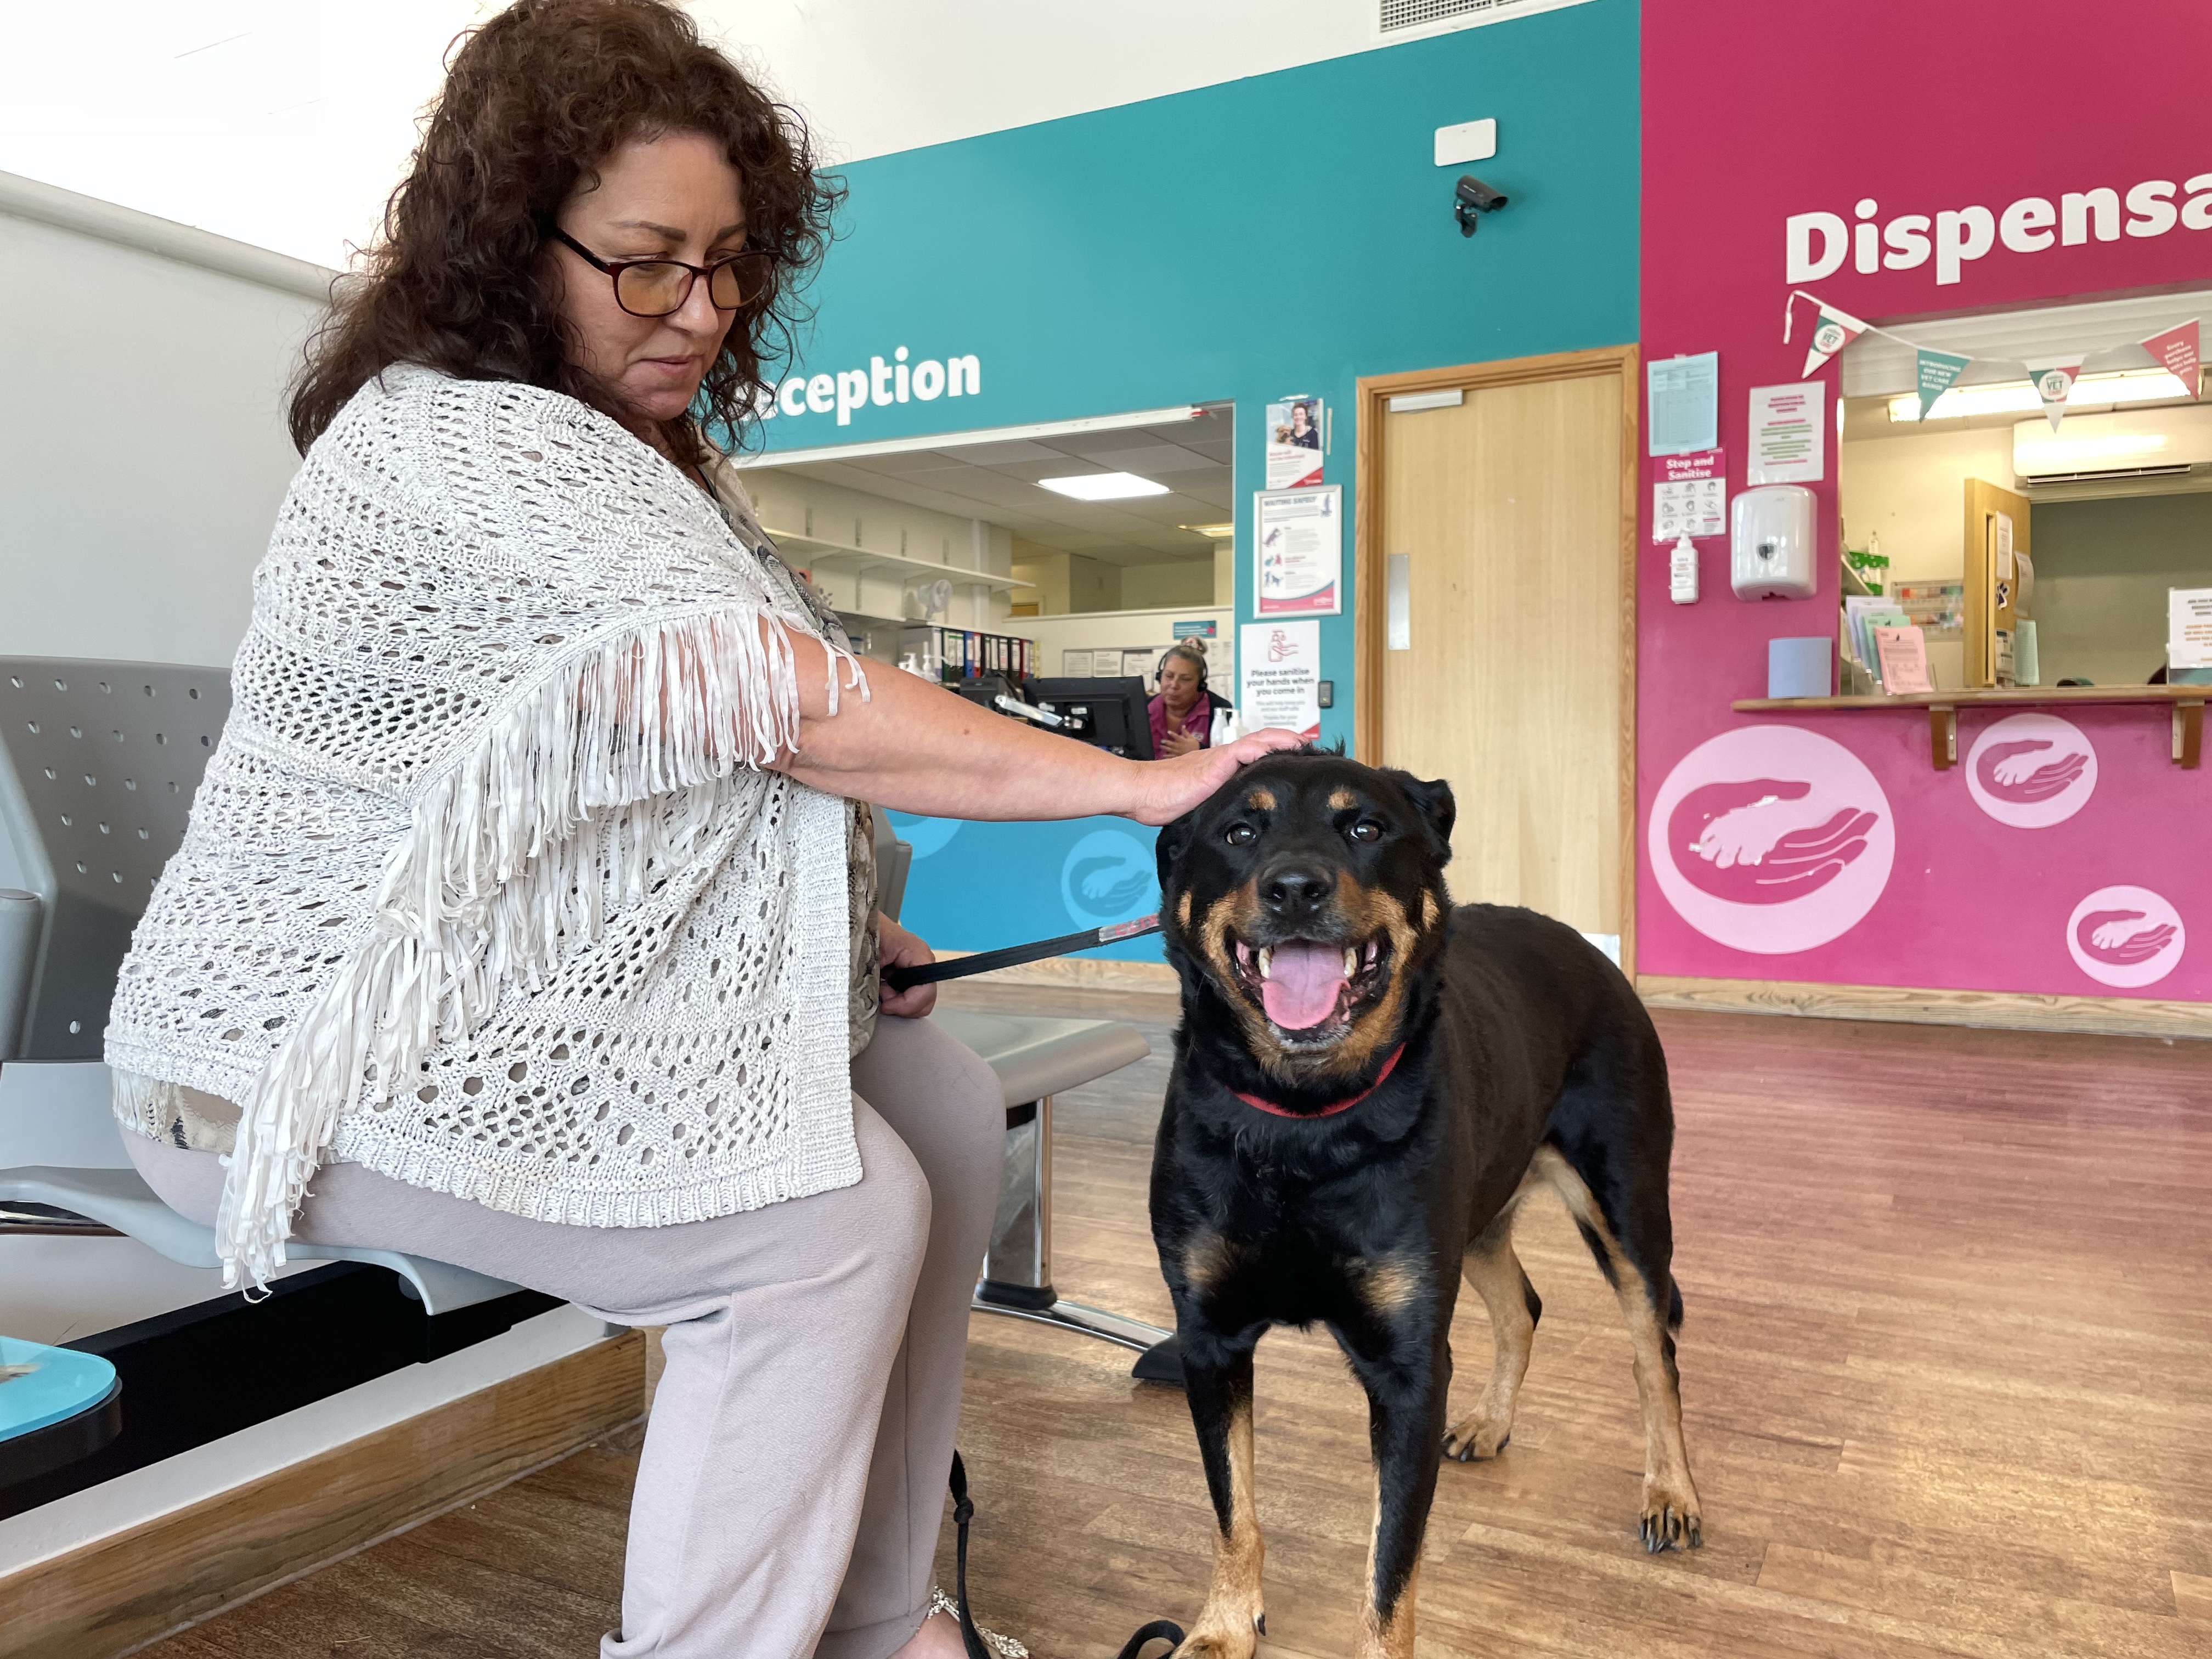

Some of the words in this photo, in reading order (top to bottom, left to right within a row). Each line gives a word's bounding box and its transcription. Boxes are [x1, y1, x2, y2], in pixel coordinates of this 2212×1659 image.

[1919, 359, 1962, 373] INTRODUCING
[1923, 366, 1937, 375] OUR
[1937, 369, 1952, 378] NEW
[732, 345, 981, 427] eception
[1933, 377, 1950, 385] CARE
[2046, 377, 2063, 390] VET
[1666, 459, 1692, 470] Stop
[1693, 455, 1715, 466] and
[1668, 469, 1712, 481] Sanitise
[1251, 669, 1278, 678] Please
[1278, 667, 1310, 676] sanitise
[1246, 679, 1265, 689] your
[1266, 678, 1291, 686] hands
[1291, 676, 1315, 685] when
[1256, 689, 1272, 697] you
[1115, 915, 1158, 935] CLIX
